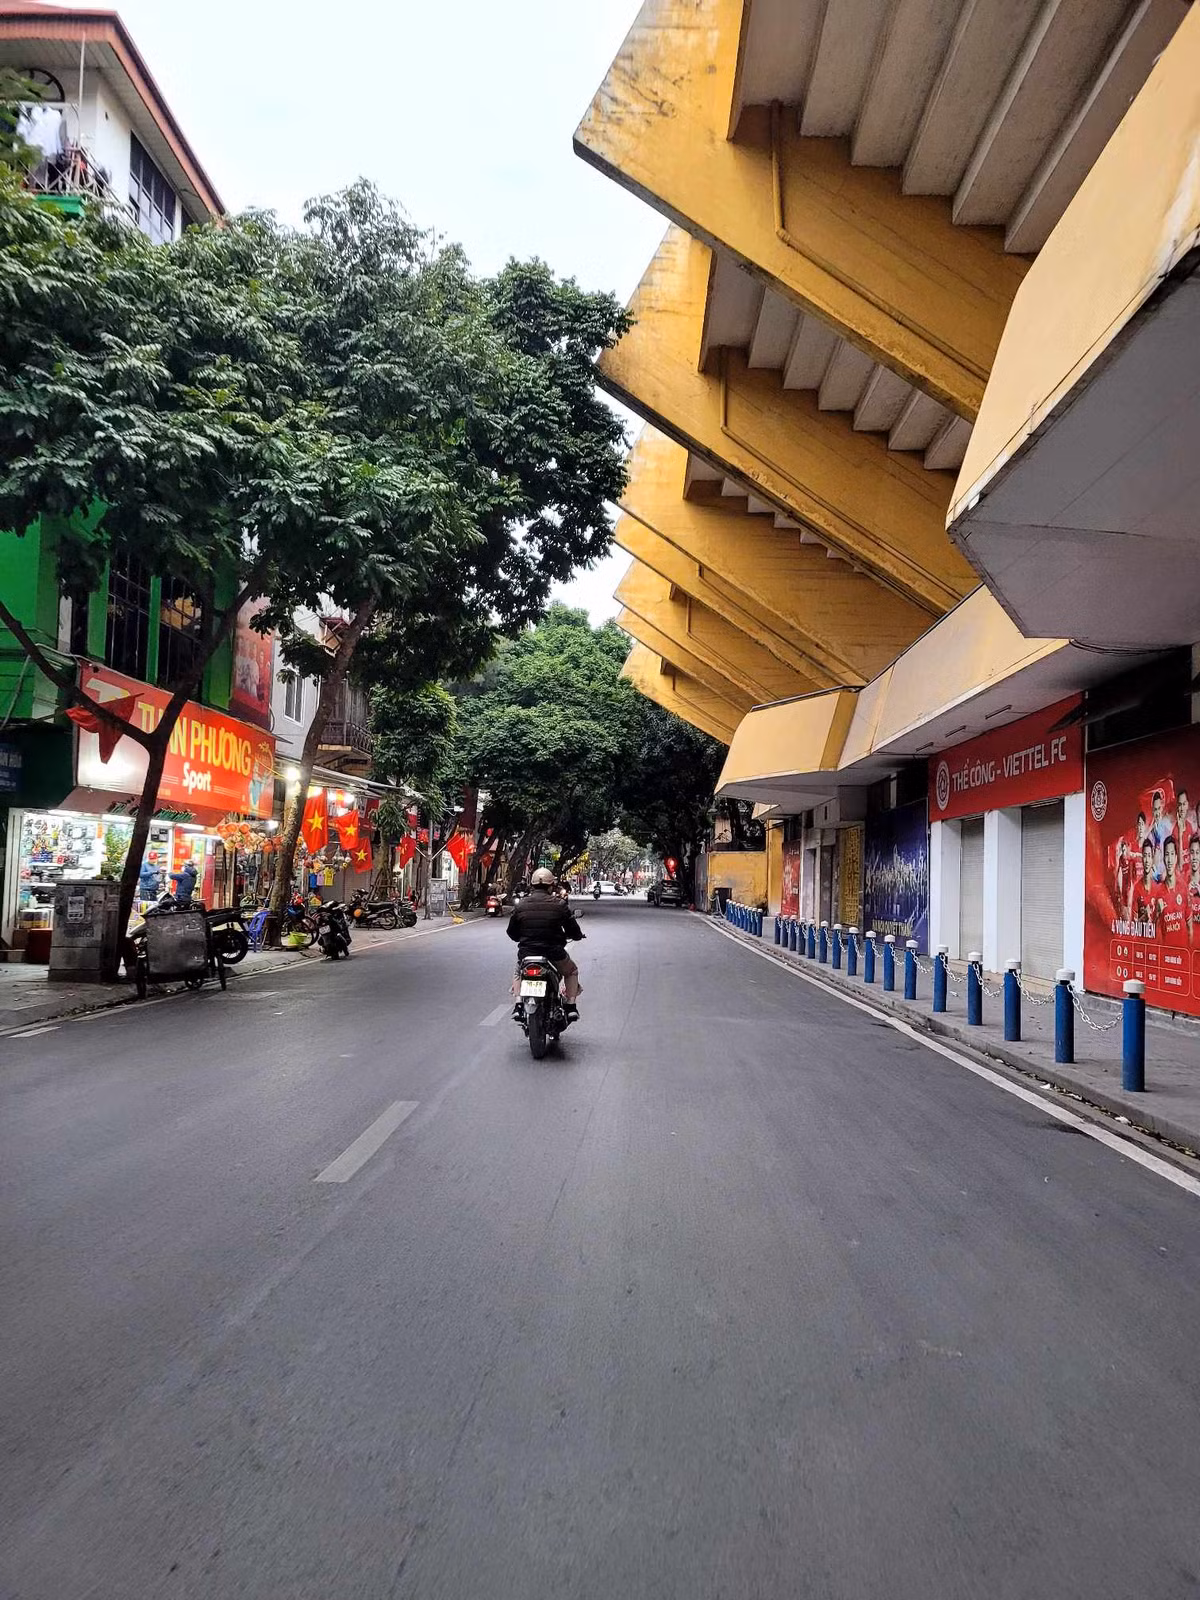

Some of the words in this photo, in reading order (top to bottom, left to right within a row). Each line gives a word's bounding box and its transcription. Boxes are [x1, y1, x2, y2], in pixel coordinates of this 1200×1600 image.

[137, 701, 187, 757] TUN
[190, 719, 252, 777] PHƯƠNG
[970, 759, 996, 787] CÔNG
[1003, 744, 1049, 779] VIETTEL
[1051, 736, 1067, 764] FC
[182, 762, 212, 795] Sport
